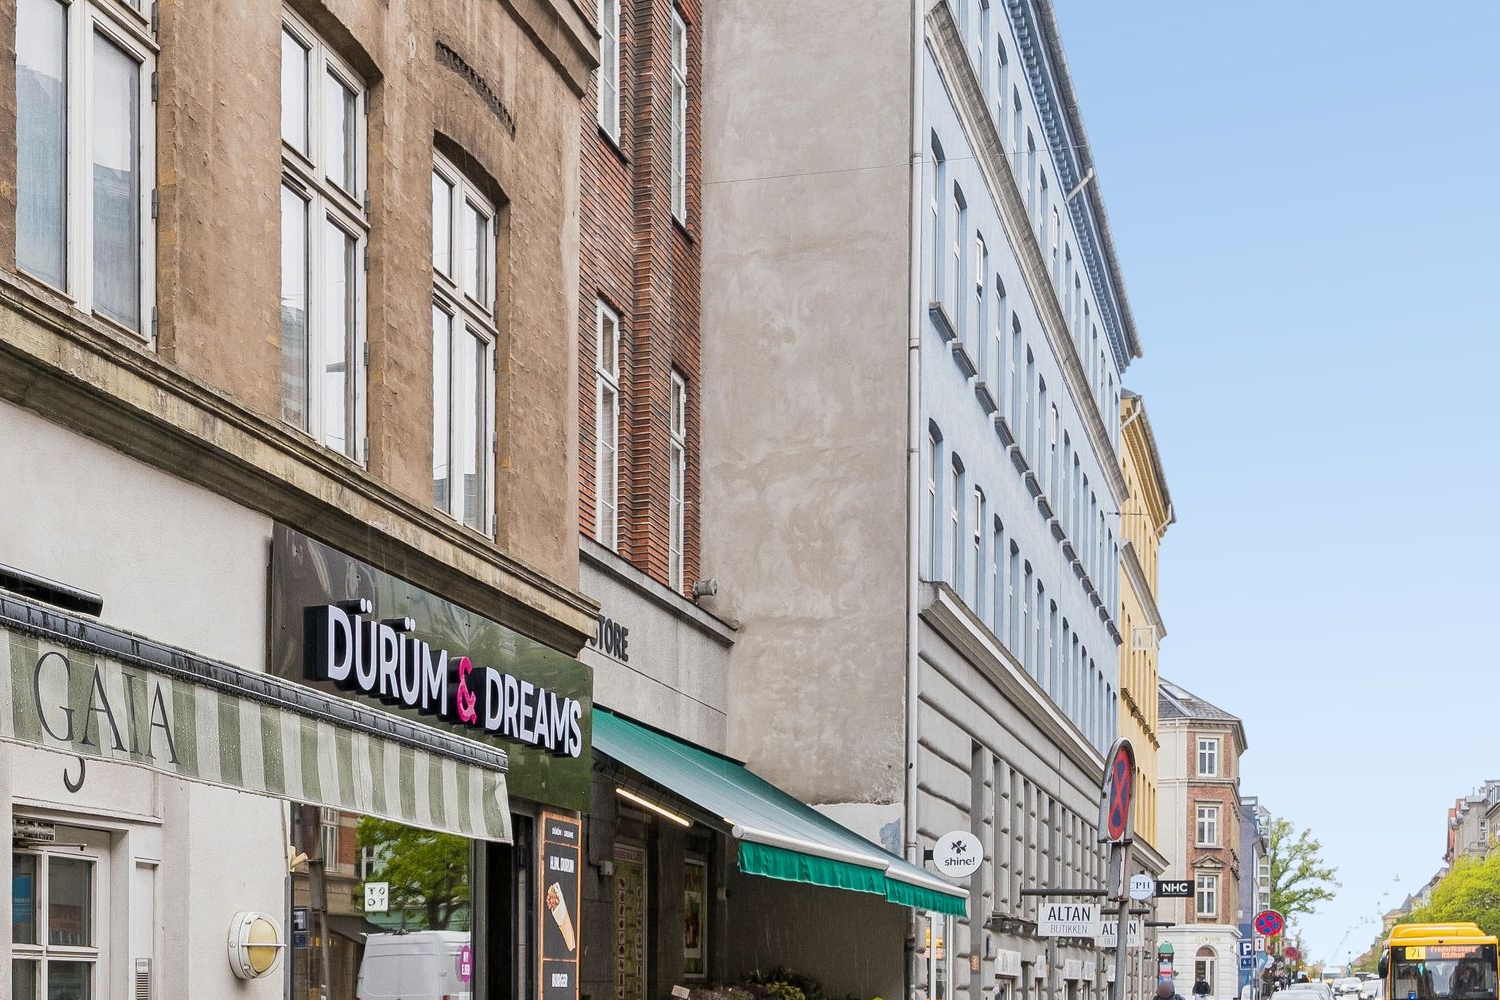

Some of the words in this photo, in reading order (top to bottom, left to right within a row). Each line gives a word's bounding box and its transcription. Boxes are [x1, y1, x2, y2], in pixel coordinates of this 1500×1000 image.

[328, 598, 448, 715] DÜRÜM
[457, 656, 477, 725] &
[485, 666, 582, 758] DREAMS
[33, 651, 181, 765] GAIA
[944, 856, 975, 867] shine!
[1162, 882, 1188, 893] NHC
[1048, 906, 1091, 921] ALTAN
[1050, 924, 1088, 934] BUTIKKEN
